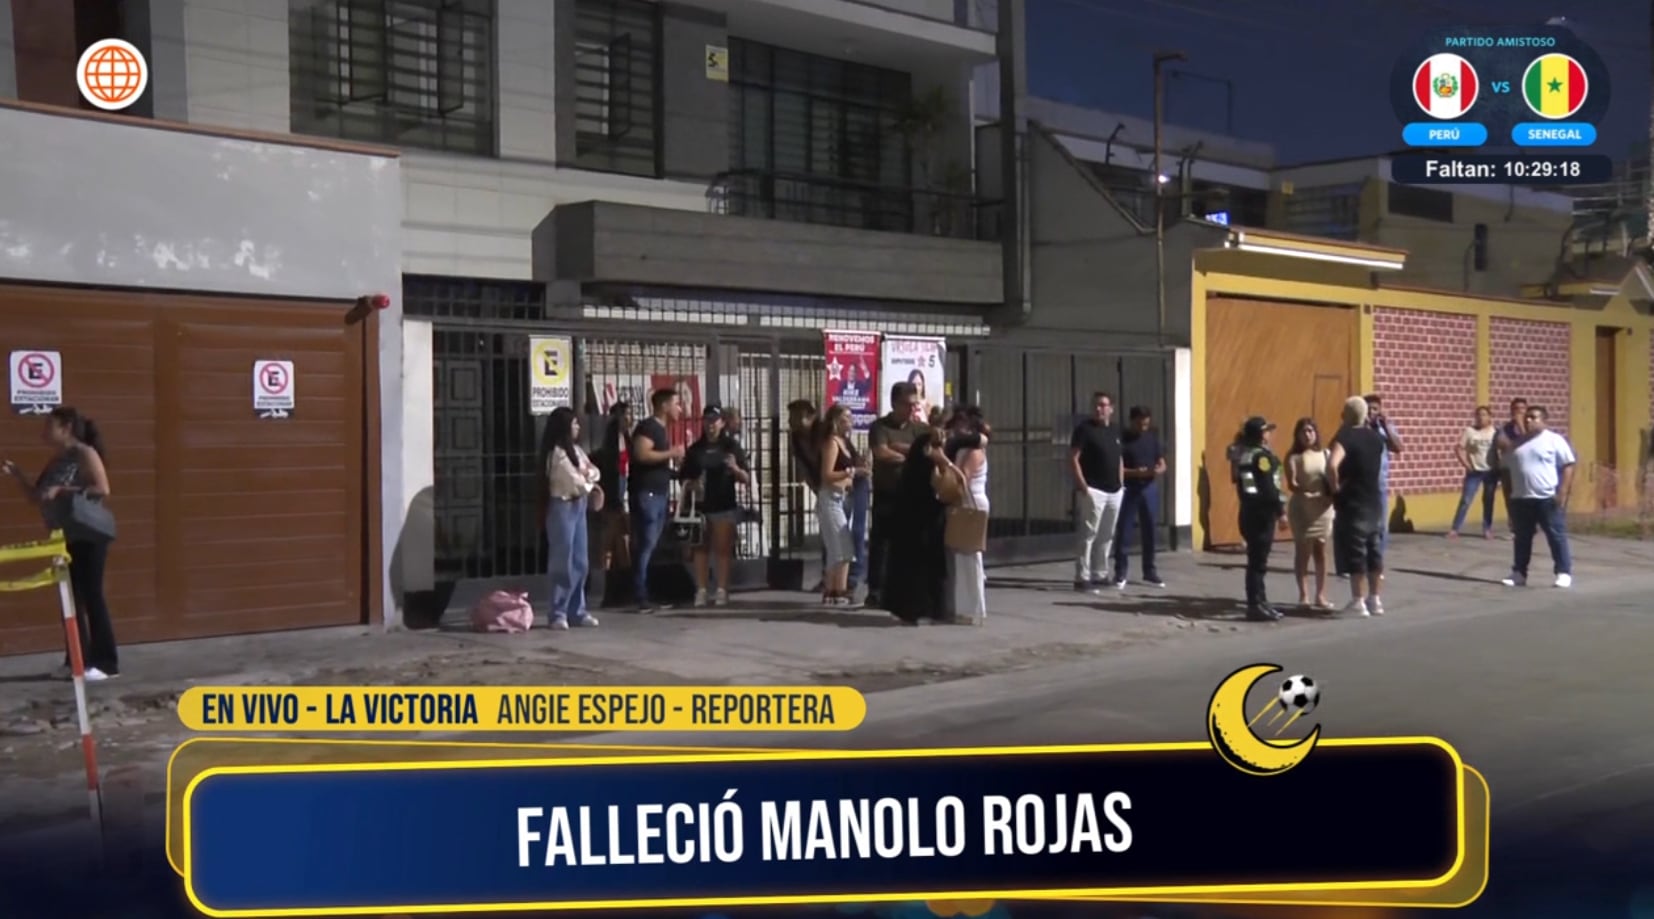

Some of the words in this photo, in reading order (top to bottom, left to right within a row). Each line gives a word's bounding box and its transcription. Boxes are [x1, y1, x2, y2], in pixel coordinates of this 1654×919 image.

[834, 343, 843, 352] EL
[928, 354, 936, 368] 5
[532, 387, 569, 398] PROHIBIDO
